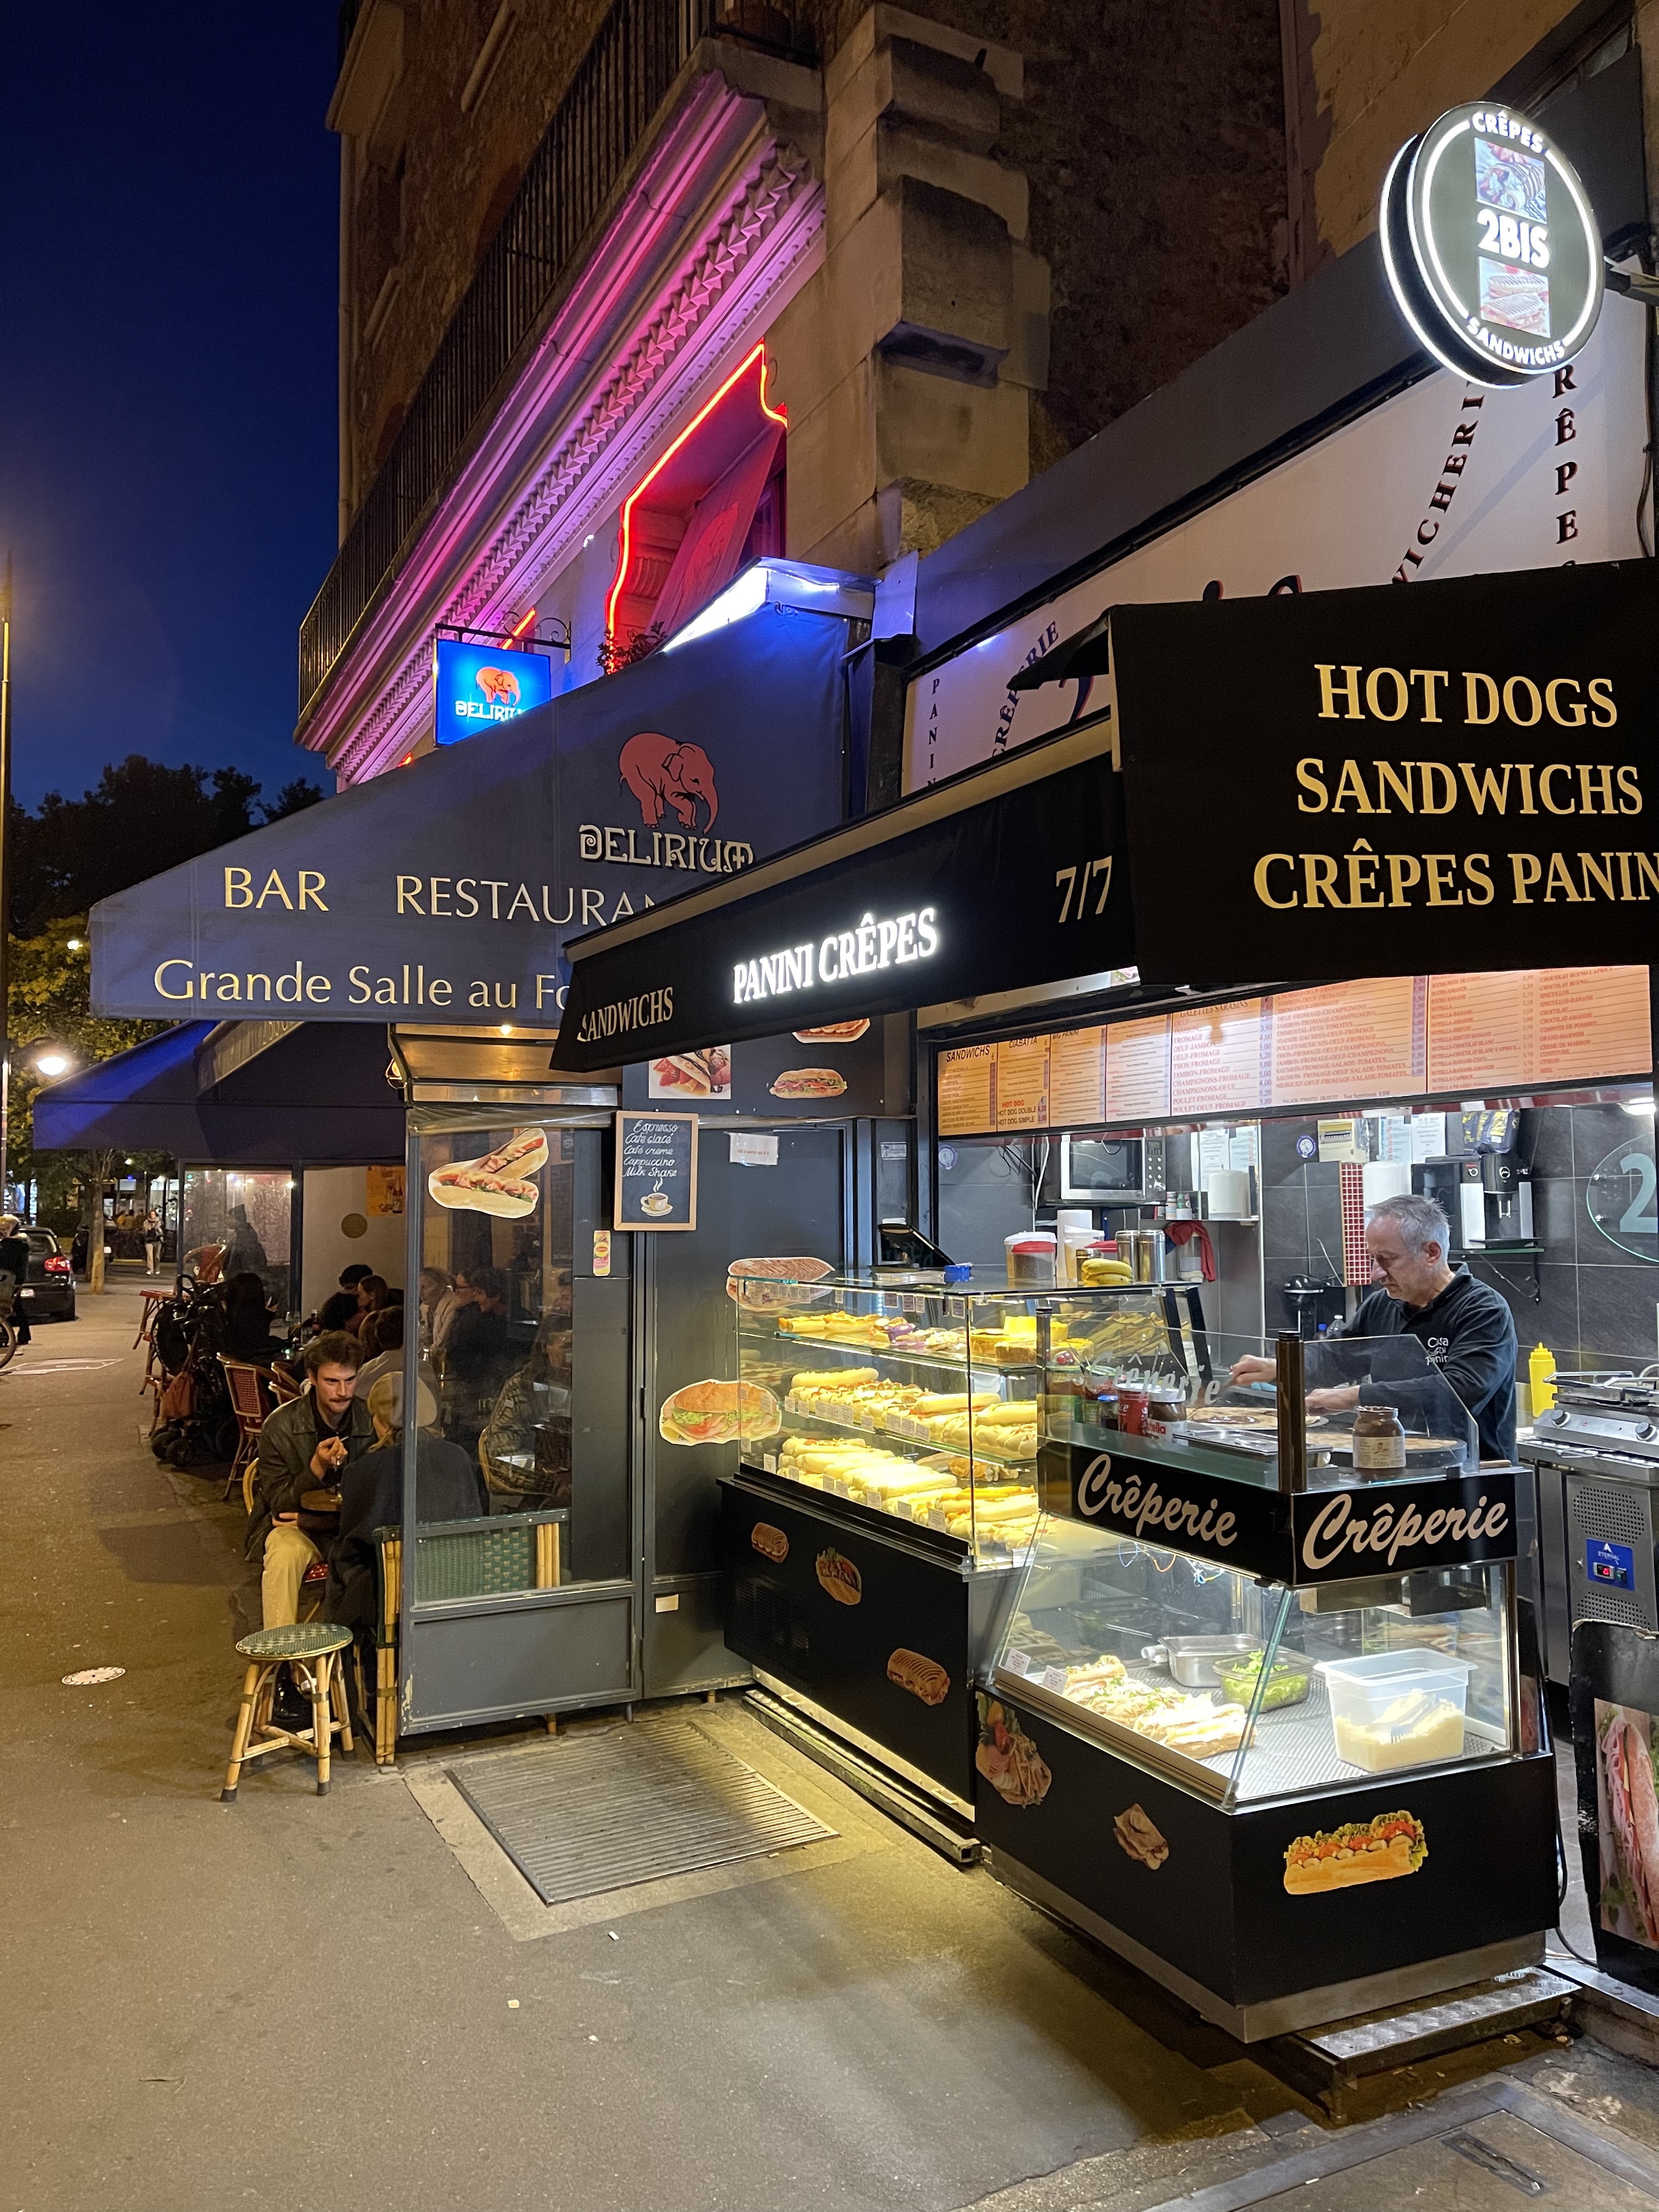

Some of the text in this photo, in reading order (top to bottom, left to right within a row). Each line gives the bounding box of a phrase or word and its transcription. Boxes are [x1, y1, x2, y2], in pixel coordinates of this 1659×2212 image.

[1472, 110, 1544, 154] CRÊPES
[1477, 209, 1551, 269] 2BIS
[1466, 315, 1566, 365] SANDWICHS
[1314, 664, 1617, 727] HOT DOGS
[1296, 758, 1643, 815] SANDWICHS
[579, 825, 754, 873] DELIRIUM
[1254, 838, 1495, 909] CRÊPES
[224, 866, 329, 911] BAR
[1056, 855, 1112, 923] 7/7
[732, 943, 814, 1005] PANINI
[818, 906, 939, 983] CRÊPES
[154, 959, 330, 1003] Grande
[348, 964, 453, 1006] Salle
[468, 979, 517, 1009] au
[946, 1045, 990, 1062] SANDWICHS
[1173, 1048, 1220, 1062] OEUF-FROMAGE
[1174, 1034, 1203, 1044] FROMAGE
[1191, 1057, 1220, 1068] FROMAGE
[633, 1120, 680, 1135] Espresso
[622, 1166, 646, 1177] Milk
[623, 1156, 675, 1167] Cappuccino
[1077, 1453, 1238, 1547] Crêperie
[1302, 1493, 1509, 1570] Crêperie
